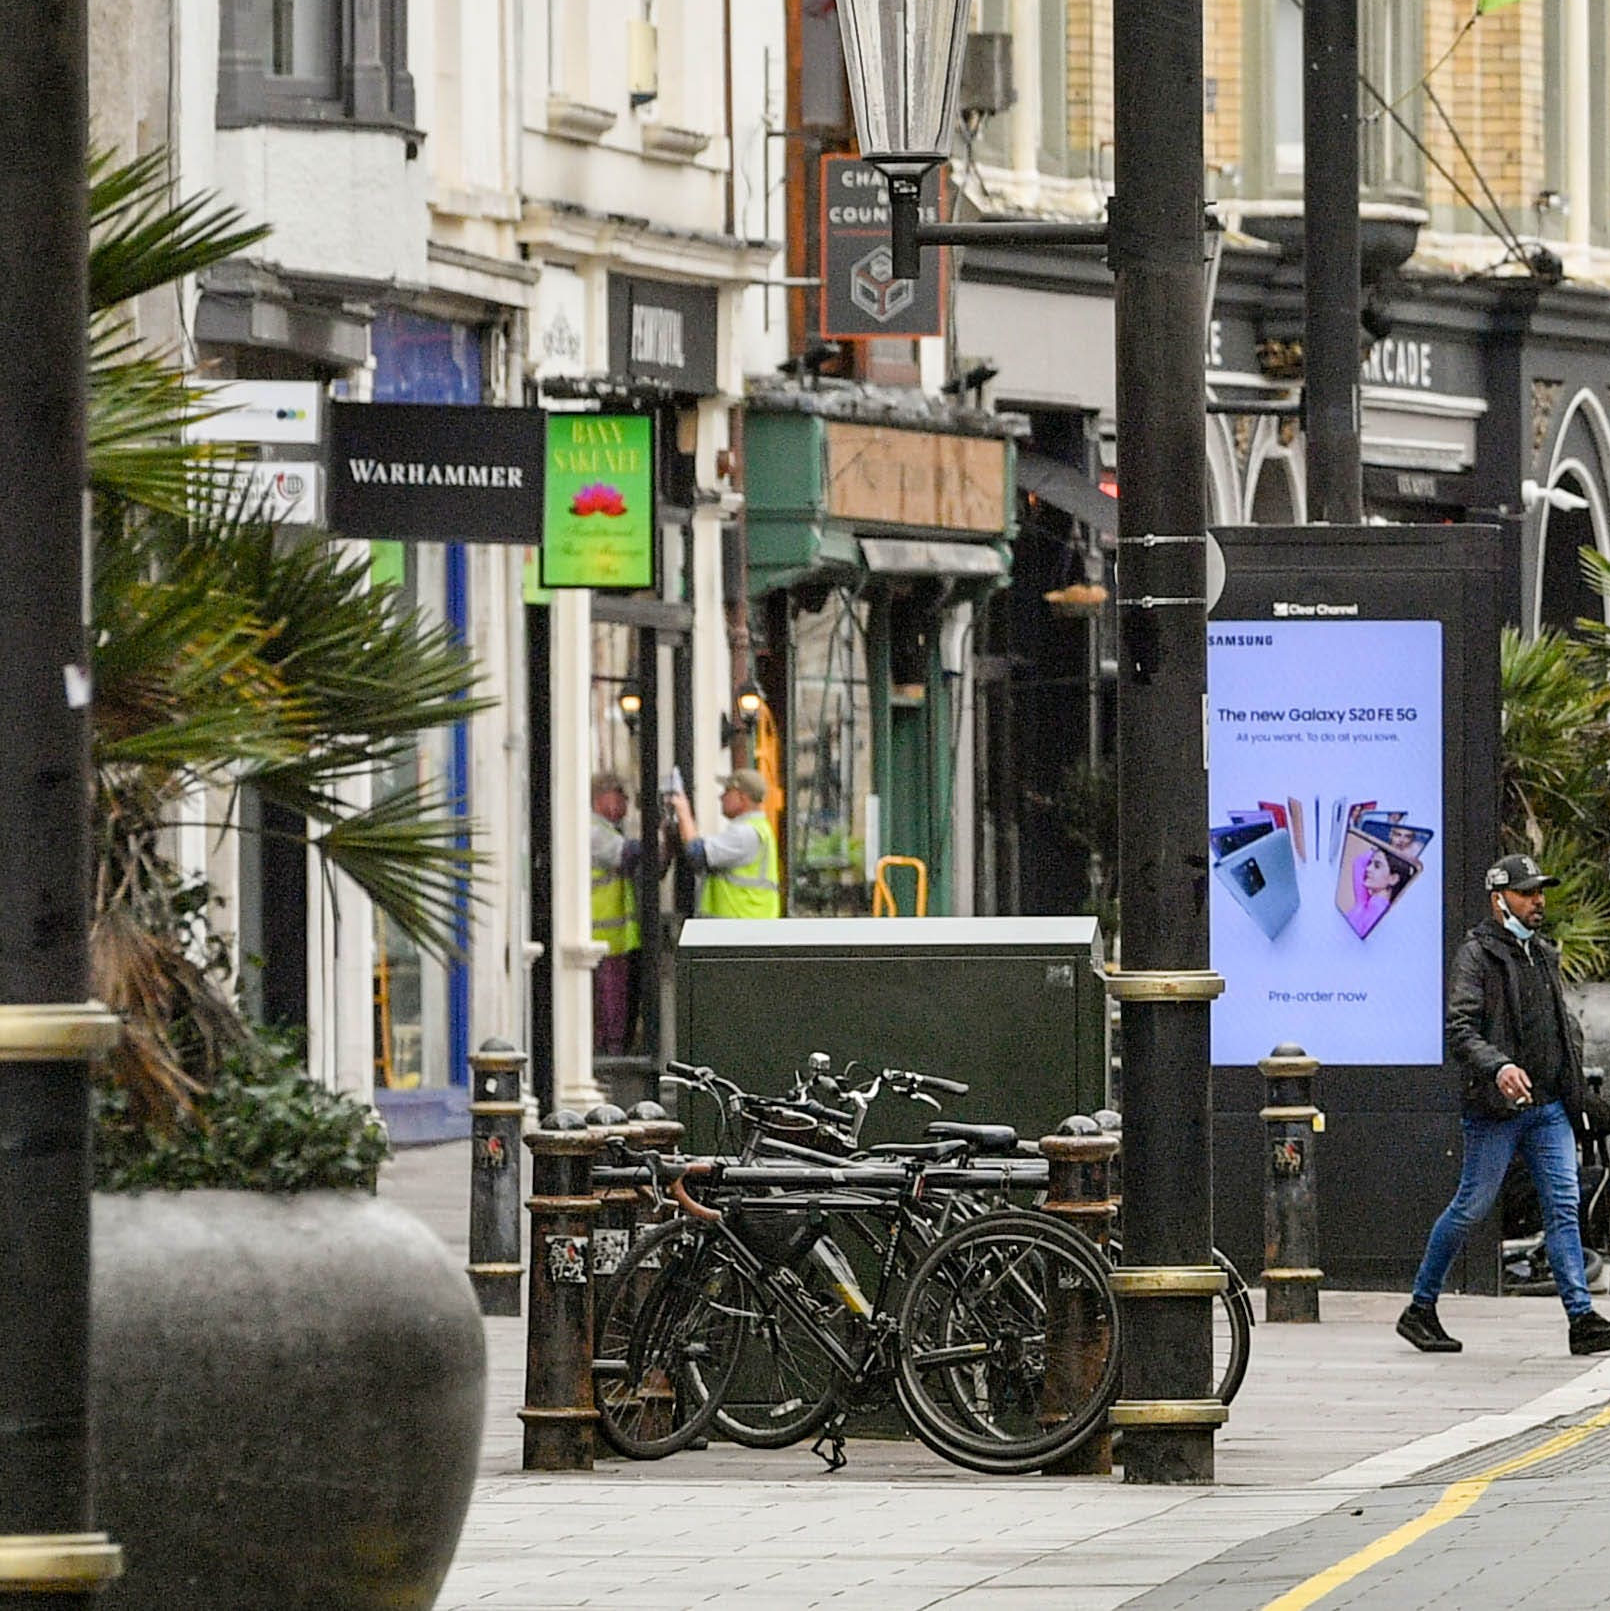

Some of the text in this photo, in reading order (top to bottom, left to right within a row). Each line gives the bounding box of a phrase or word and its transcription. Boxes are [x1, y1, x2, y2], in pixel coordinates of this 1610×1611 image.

[841, 170, 889, 188] CHA
[829, 206, 938, 224] COUNS
[350, 458, 523, 488] WARHAMMER
[1289, 602, 1358, 616] Clear Channel
[1207, 635, 1274, 647] SAMSUNG
[1217, 707, 1418, 725] The new Galaxy S20 FE 5G
[1251, 735, 1271, 745] you
[1273, 733, 1302, 742] want.
[1306, 732, 1318, 742] To
[1320, 732, 1334, 742] do
[1352, 735, 1372, 744] you
[1374, 732, 1400, 742] love.
[1268, 990, 1367, 1002] Pre-order now
